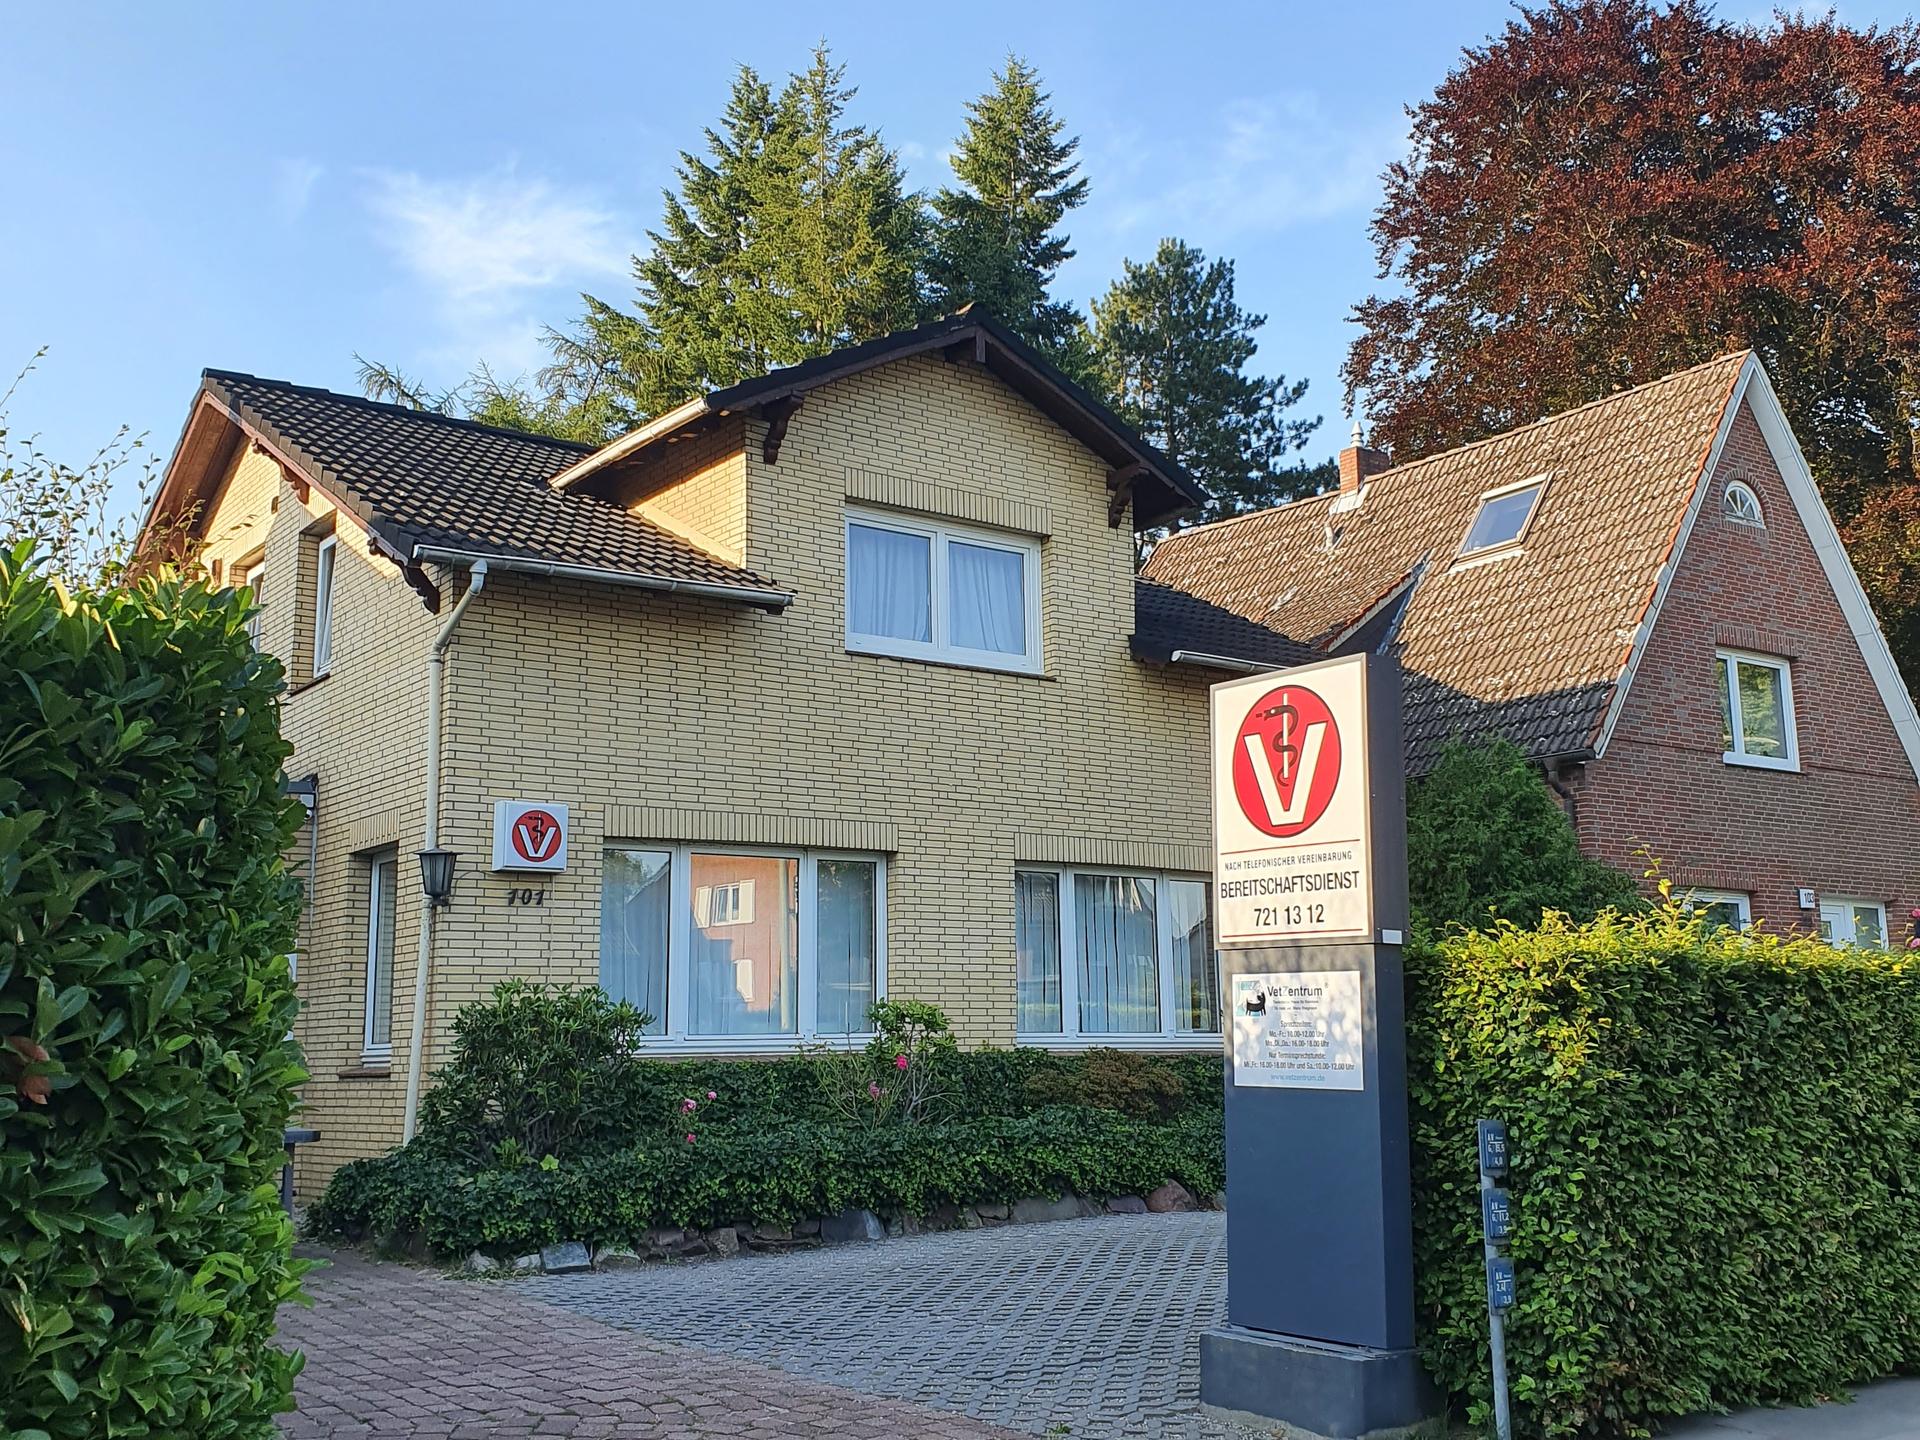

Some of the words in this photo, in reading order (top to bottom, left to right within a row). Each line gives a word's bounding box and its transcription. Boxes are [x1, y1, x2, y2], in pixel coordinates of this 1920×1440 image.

[1243, 720, 1329, 827] V
[518, 824, 557, 858] V
[1224, 861, 1242, 871] NACH
[1243, 855, 1296, 870] TELEFONISCHER
[1297, 850, 1353, 864] VEREINBARUNG
[1220, 870, 1360, 899] BEREITSCHAFTSDIENST
[507, 888, 546, 906] 101
[1804, 892, 1814, 904] 103
[1254, 907, 1278, 927] 721
[1284, 905, 1302, 925] 13
[1306, 903, 1325, 923] 12
